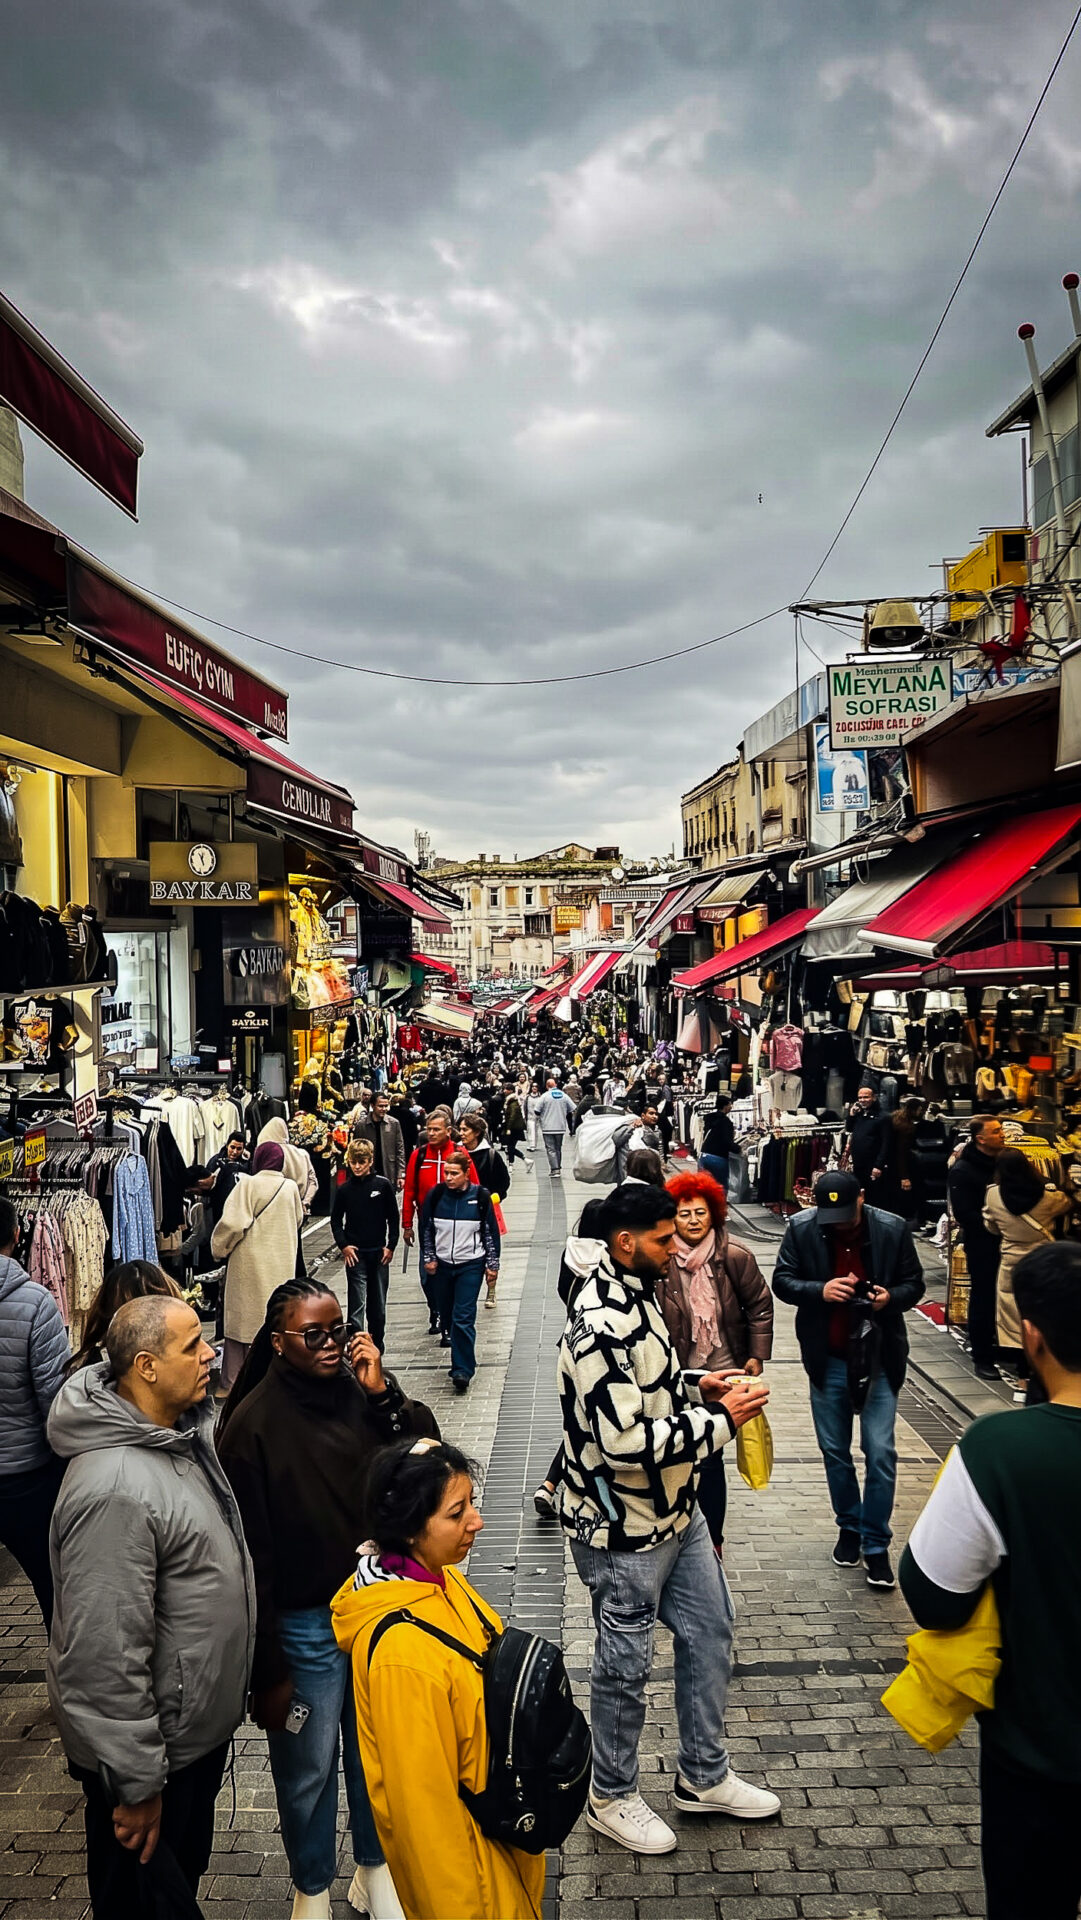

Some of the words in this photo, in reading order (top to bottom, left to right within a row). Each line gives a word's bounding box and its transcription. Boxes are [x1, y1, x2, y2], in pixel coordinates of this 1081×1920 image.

[832, 665, 947, 697] MEYLANA
[845, 696, 937, 716] SOFRASI
[150, 881, 253, 900] BAYKAR
[249, 947, 284, 976] BAYKAR
